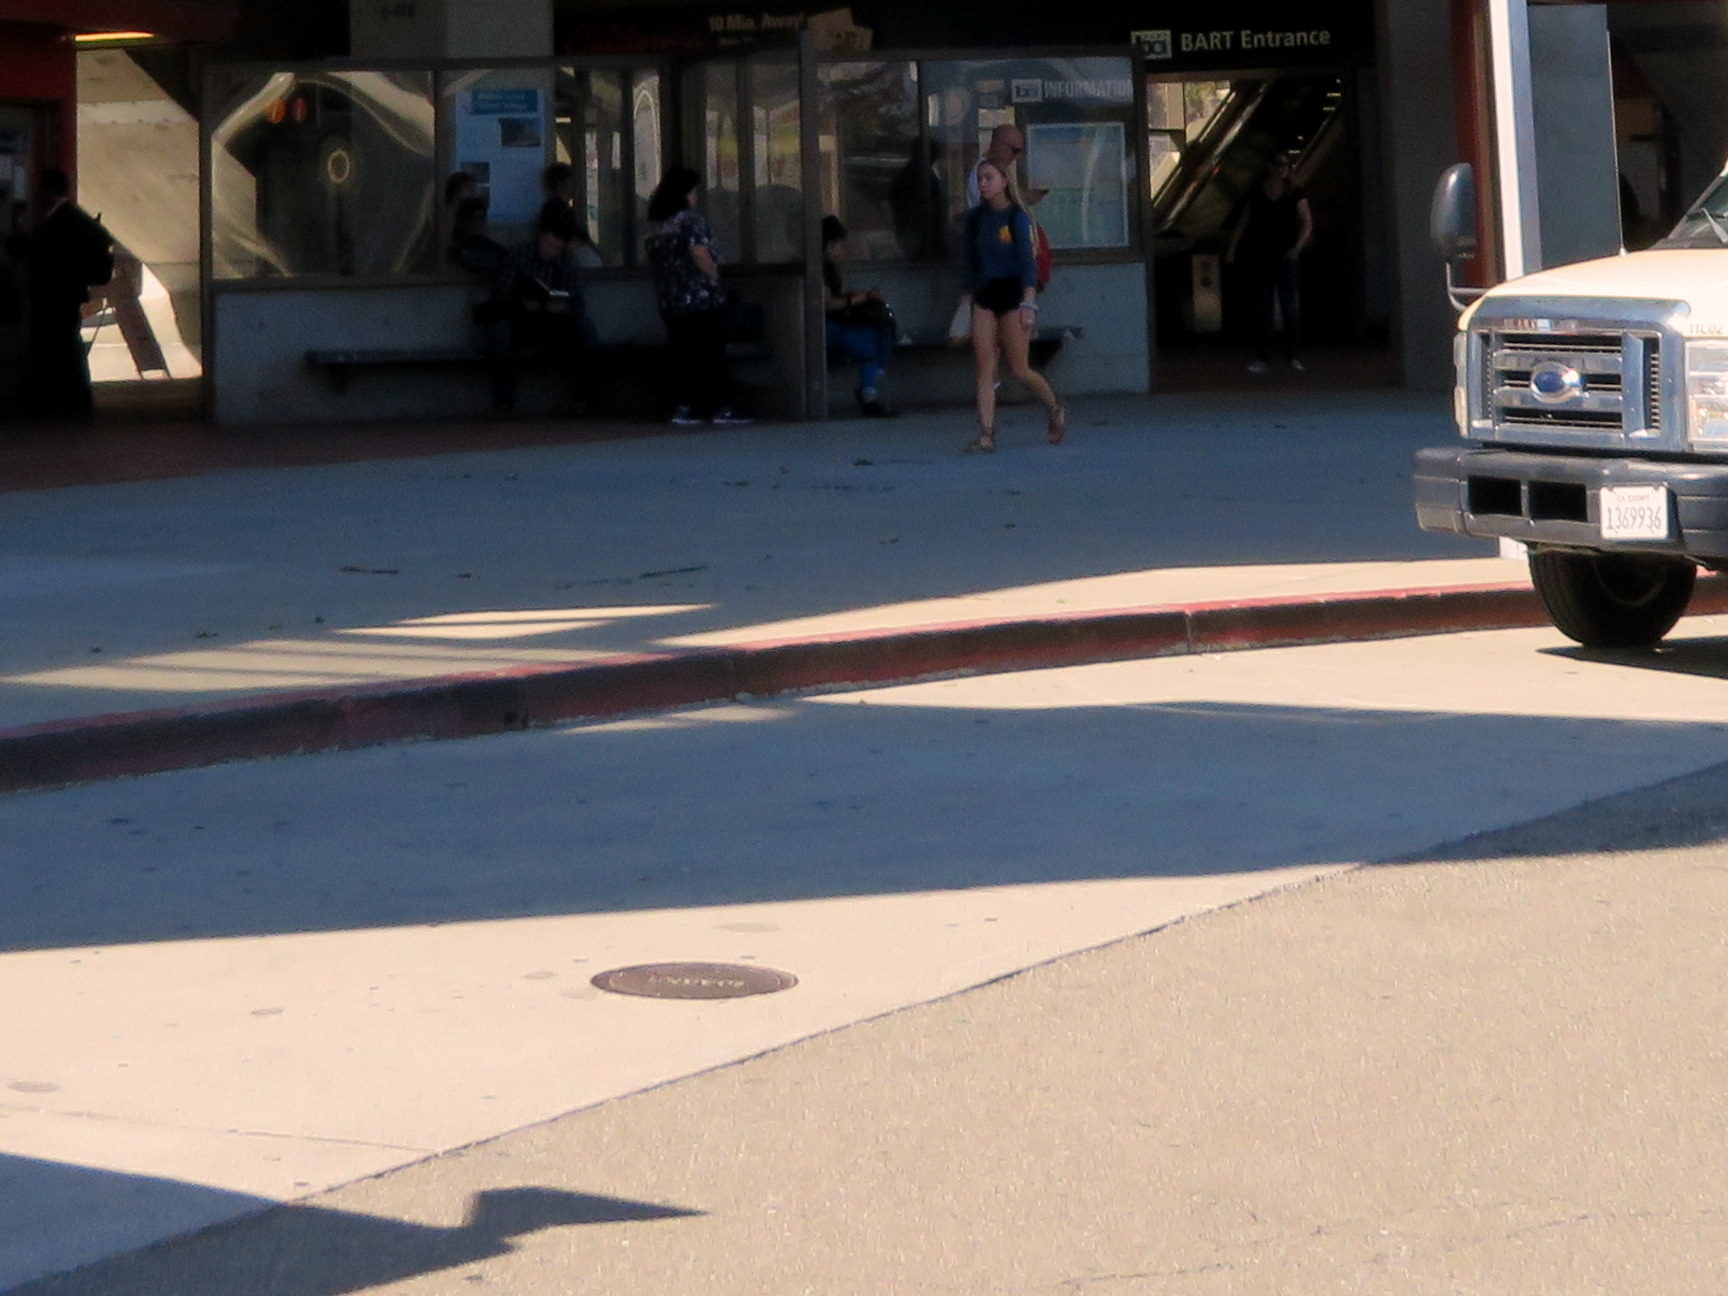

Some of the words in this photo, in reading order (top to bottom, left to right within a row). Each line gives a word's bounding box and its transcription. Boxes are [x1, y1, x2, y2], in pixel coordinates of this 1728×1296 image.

[1181, 31, 1234, 52] BART
[1241, 28, 1332, 50] Entrance
[1607, 506, 1662, 530] 1369936
